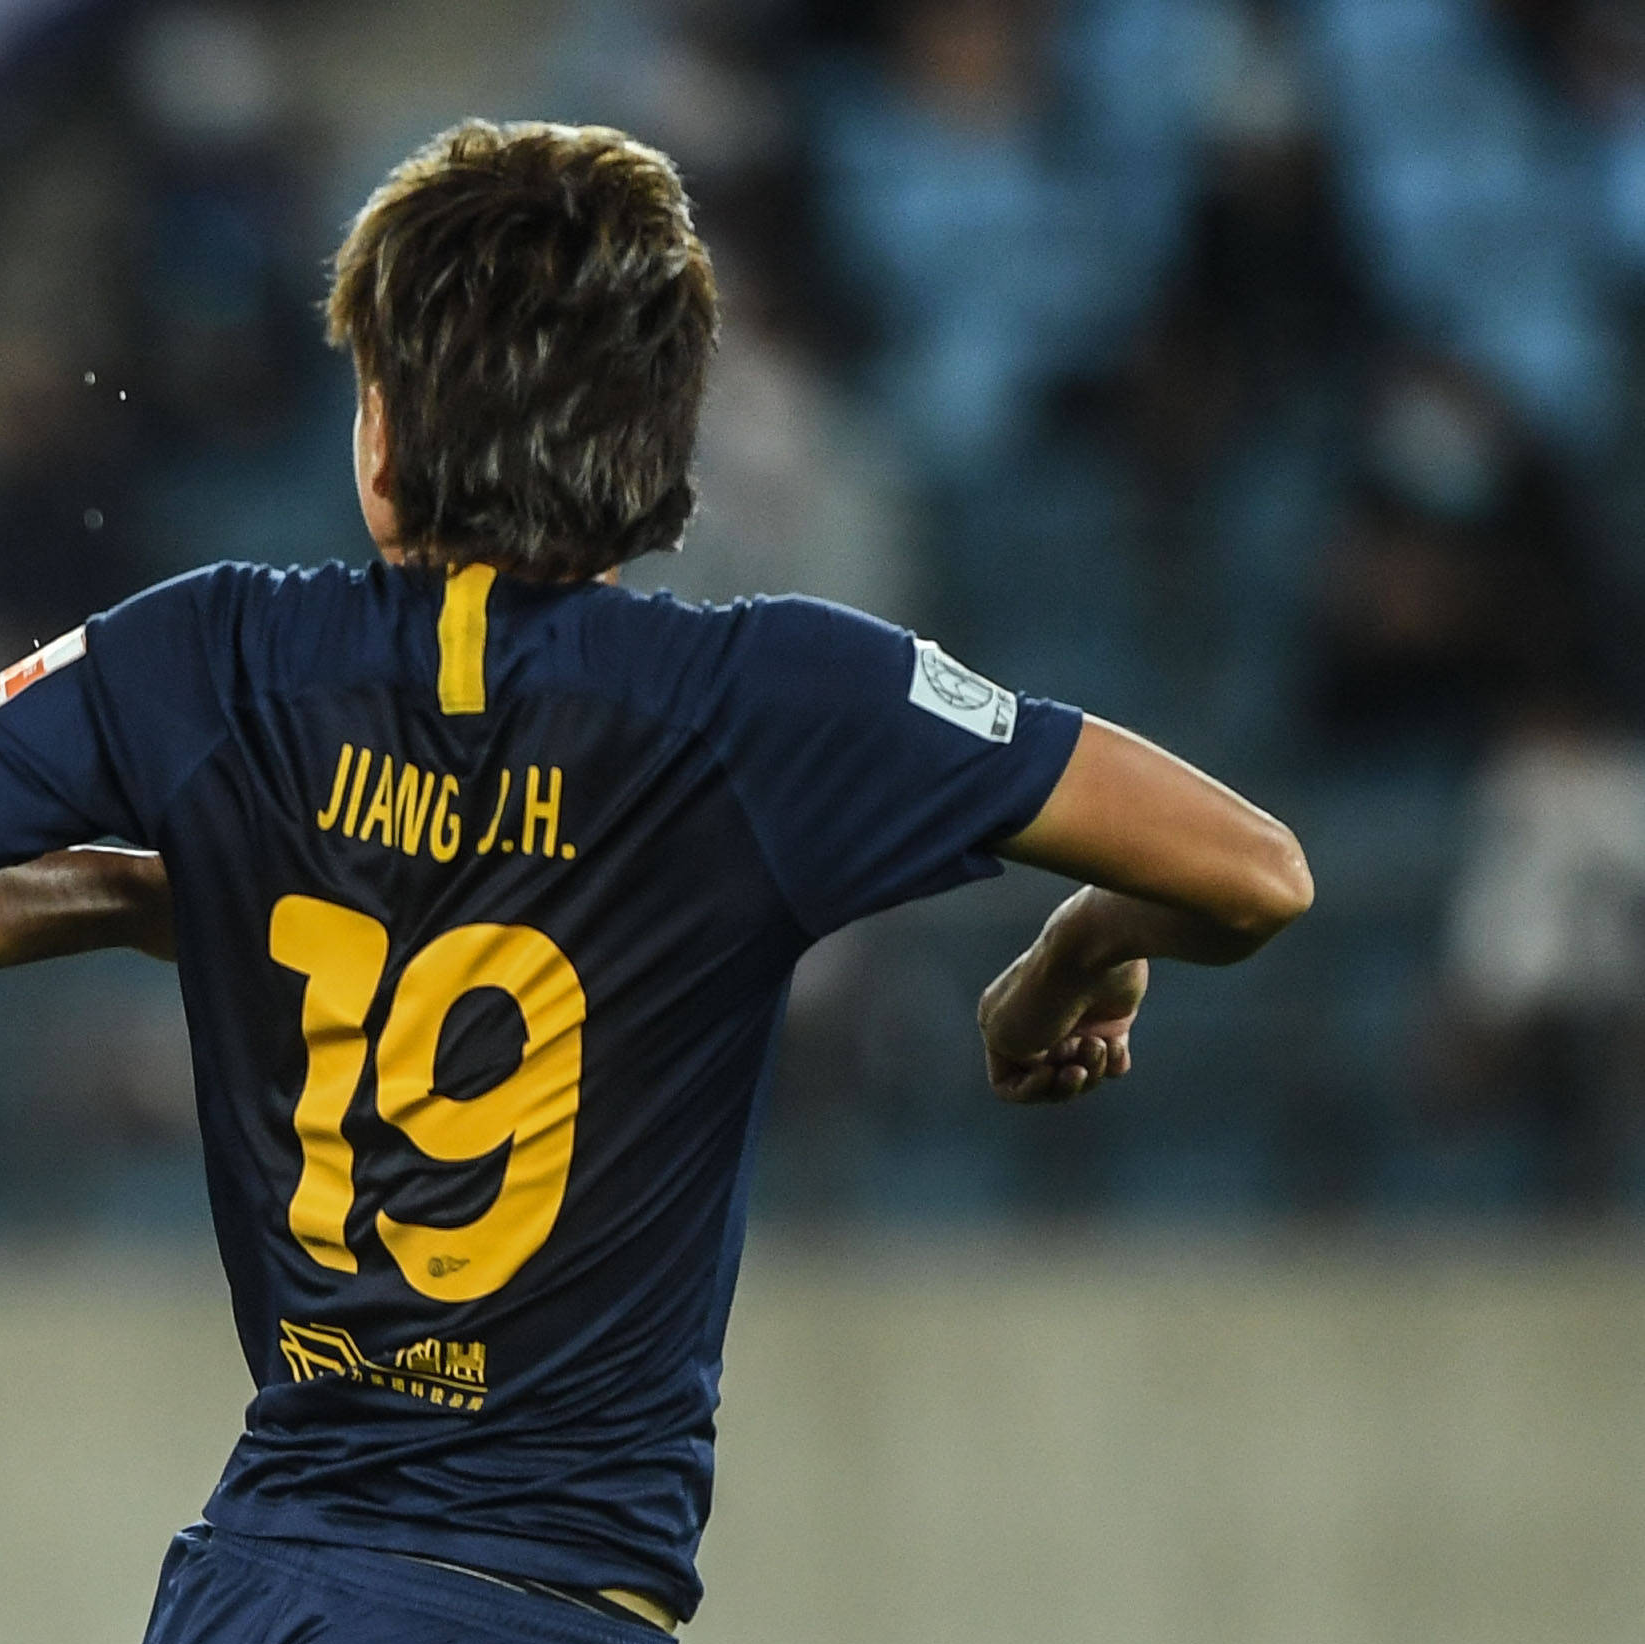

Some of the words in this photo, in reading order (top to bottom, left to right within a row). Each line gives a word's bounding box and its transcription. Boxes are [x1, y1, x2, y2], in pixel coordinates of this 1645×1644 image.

[315, 742, 463, 864] JIANG
[476, 765, 578, 861] J.H.
[268, 893, 588, 1303] 19
